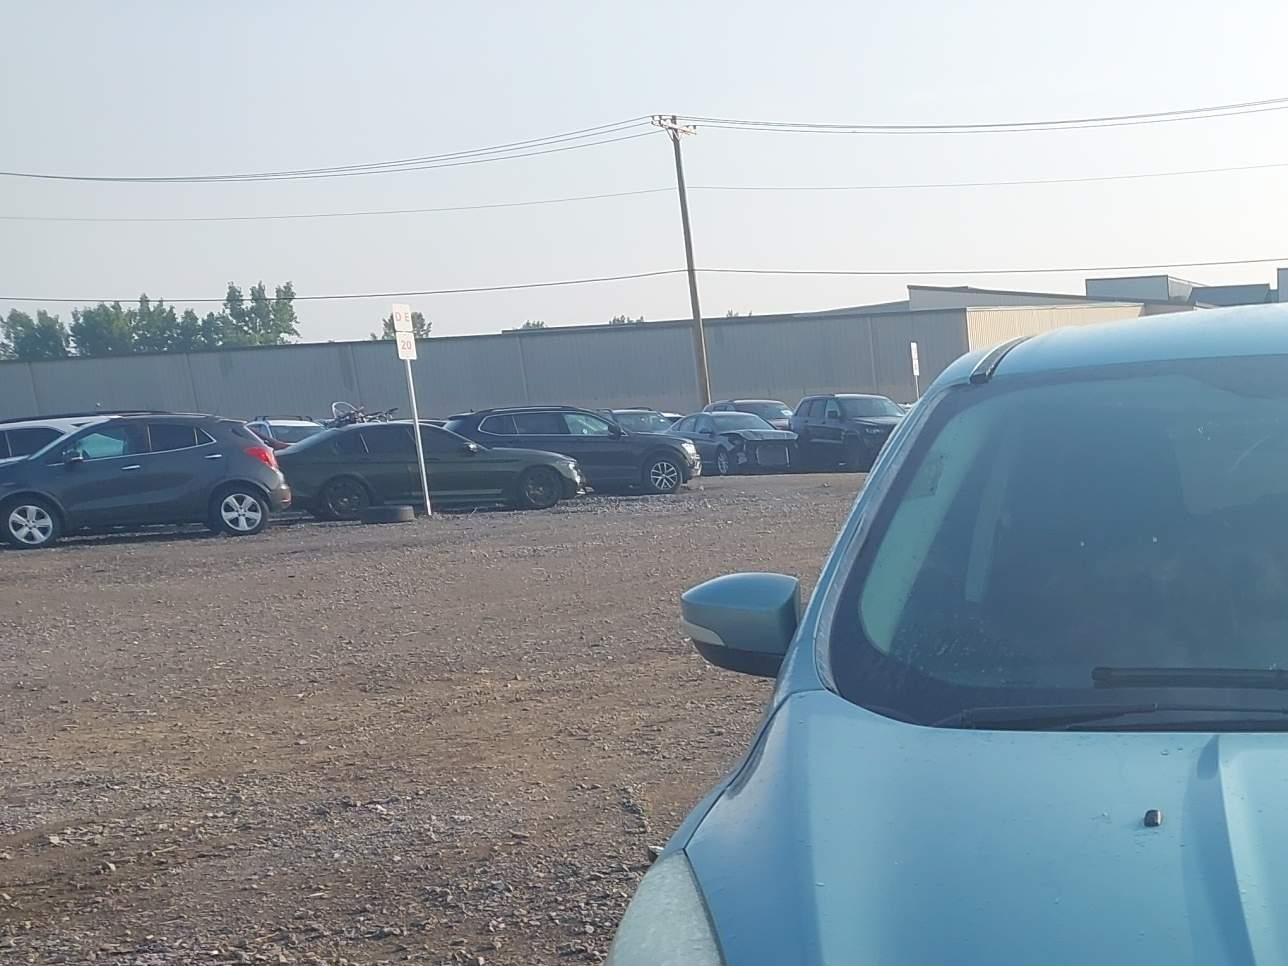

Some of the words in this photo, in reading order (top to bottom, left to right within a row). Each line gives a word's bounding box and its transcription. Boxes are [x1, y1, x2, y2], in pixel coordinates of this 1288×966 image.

[395, 312, 402, 322] D
[404, 312, 410, 322] E
[401, 341, 412, 350] 20
